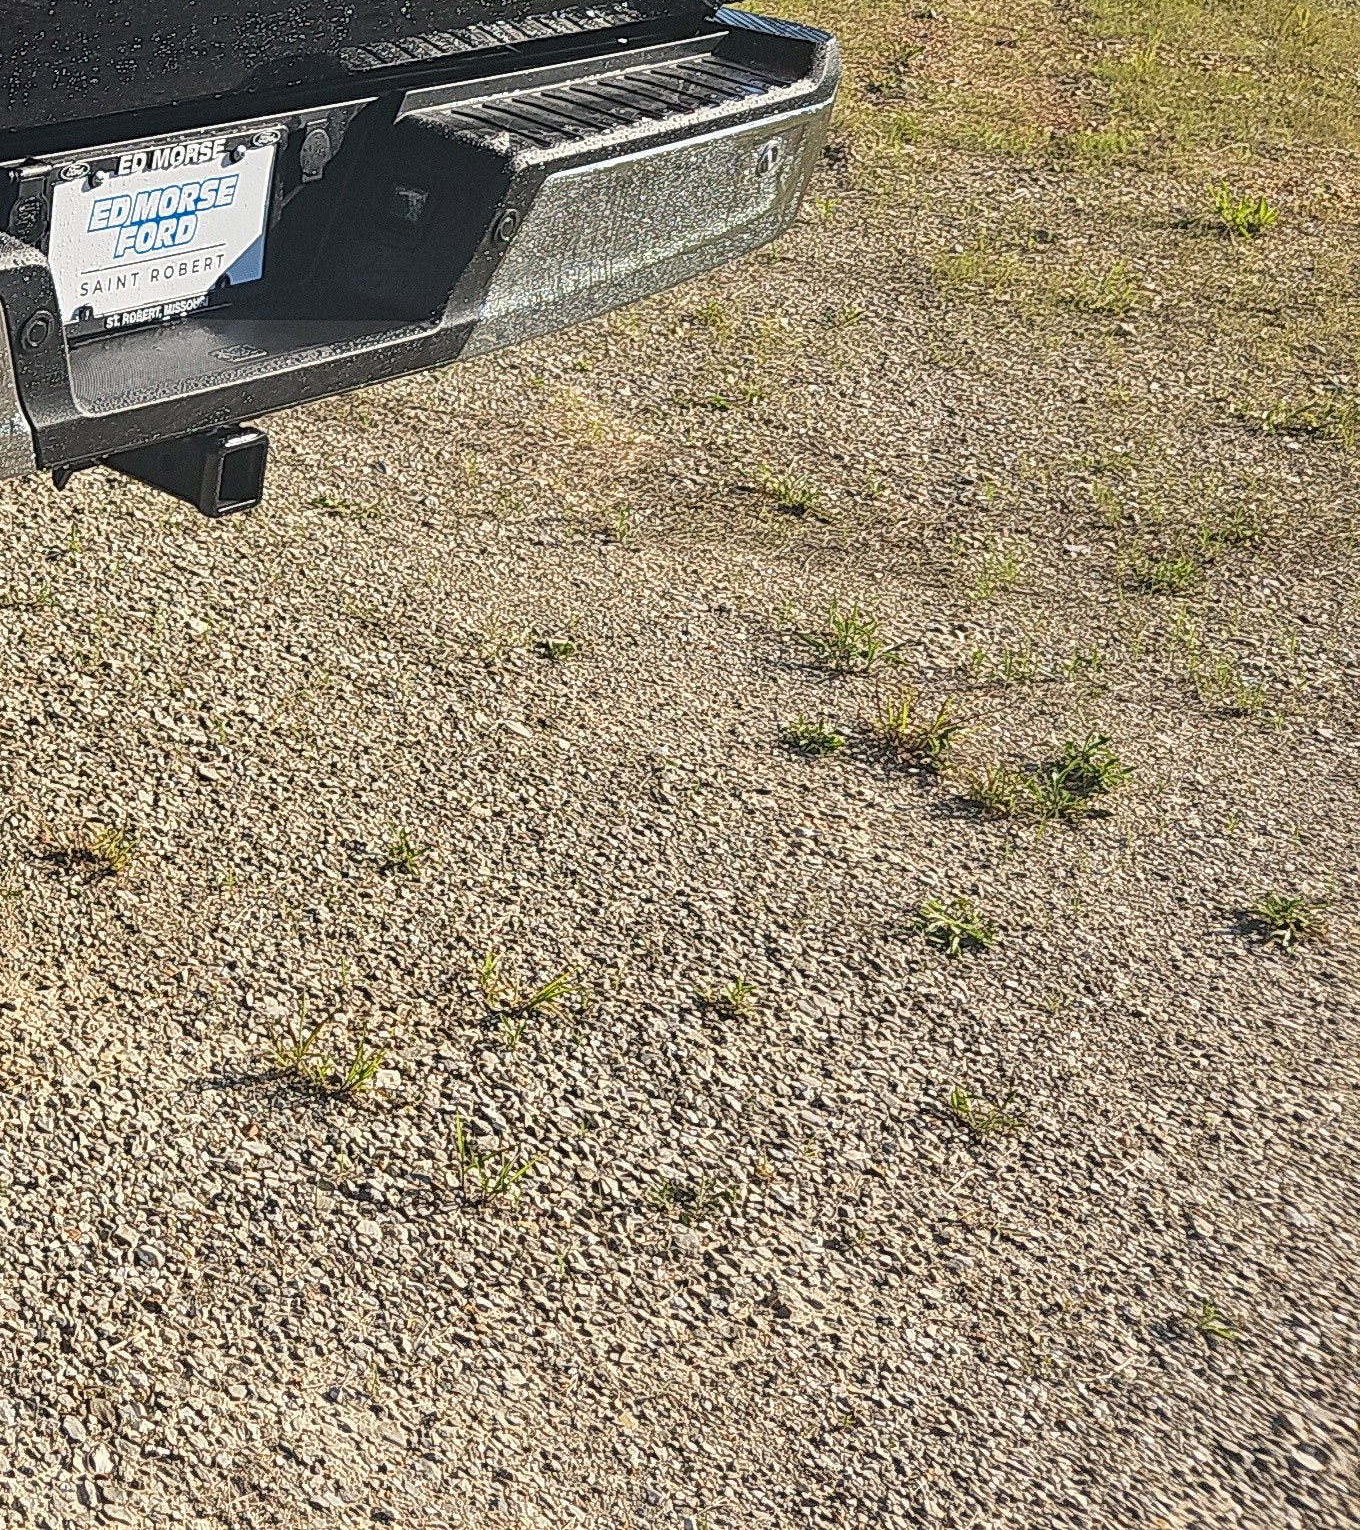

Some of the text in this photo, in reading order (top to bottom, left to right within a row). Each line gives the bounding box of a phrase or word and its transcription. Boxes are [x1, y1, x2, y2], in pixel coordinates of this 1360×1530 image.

[118, 139, 226, 176] ED MORSE
[87, 174, 239, 233] ED MORSE
[113, 214, 198, 259] FORD
[80, 254, 226, 297] SAINT ROBERT
